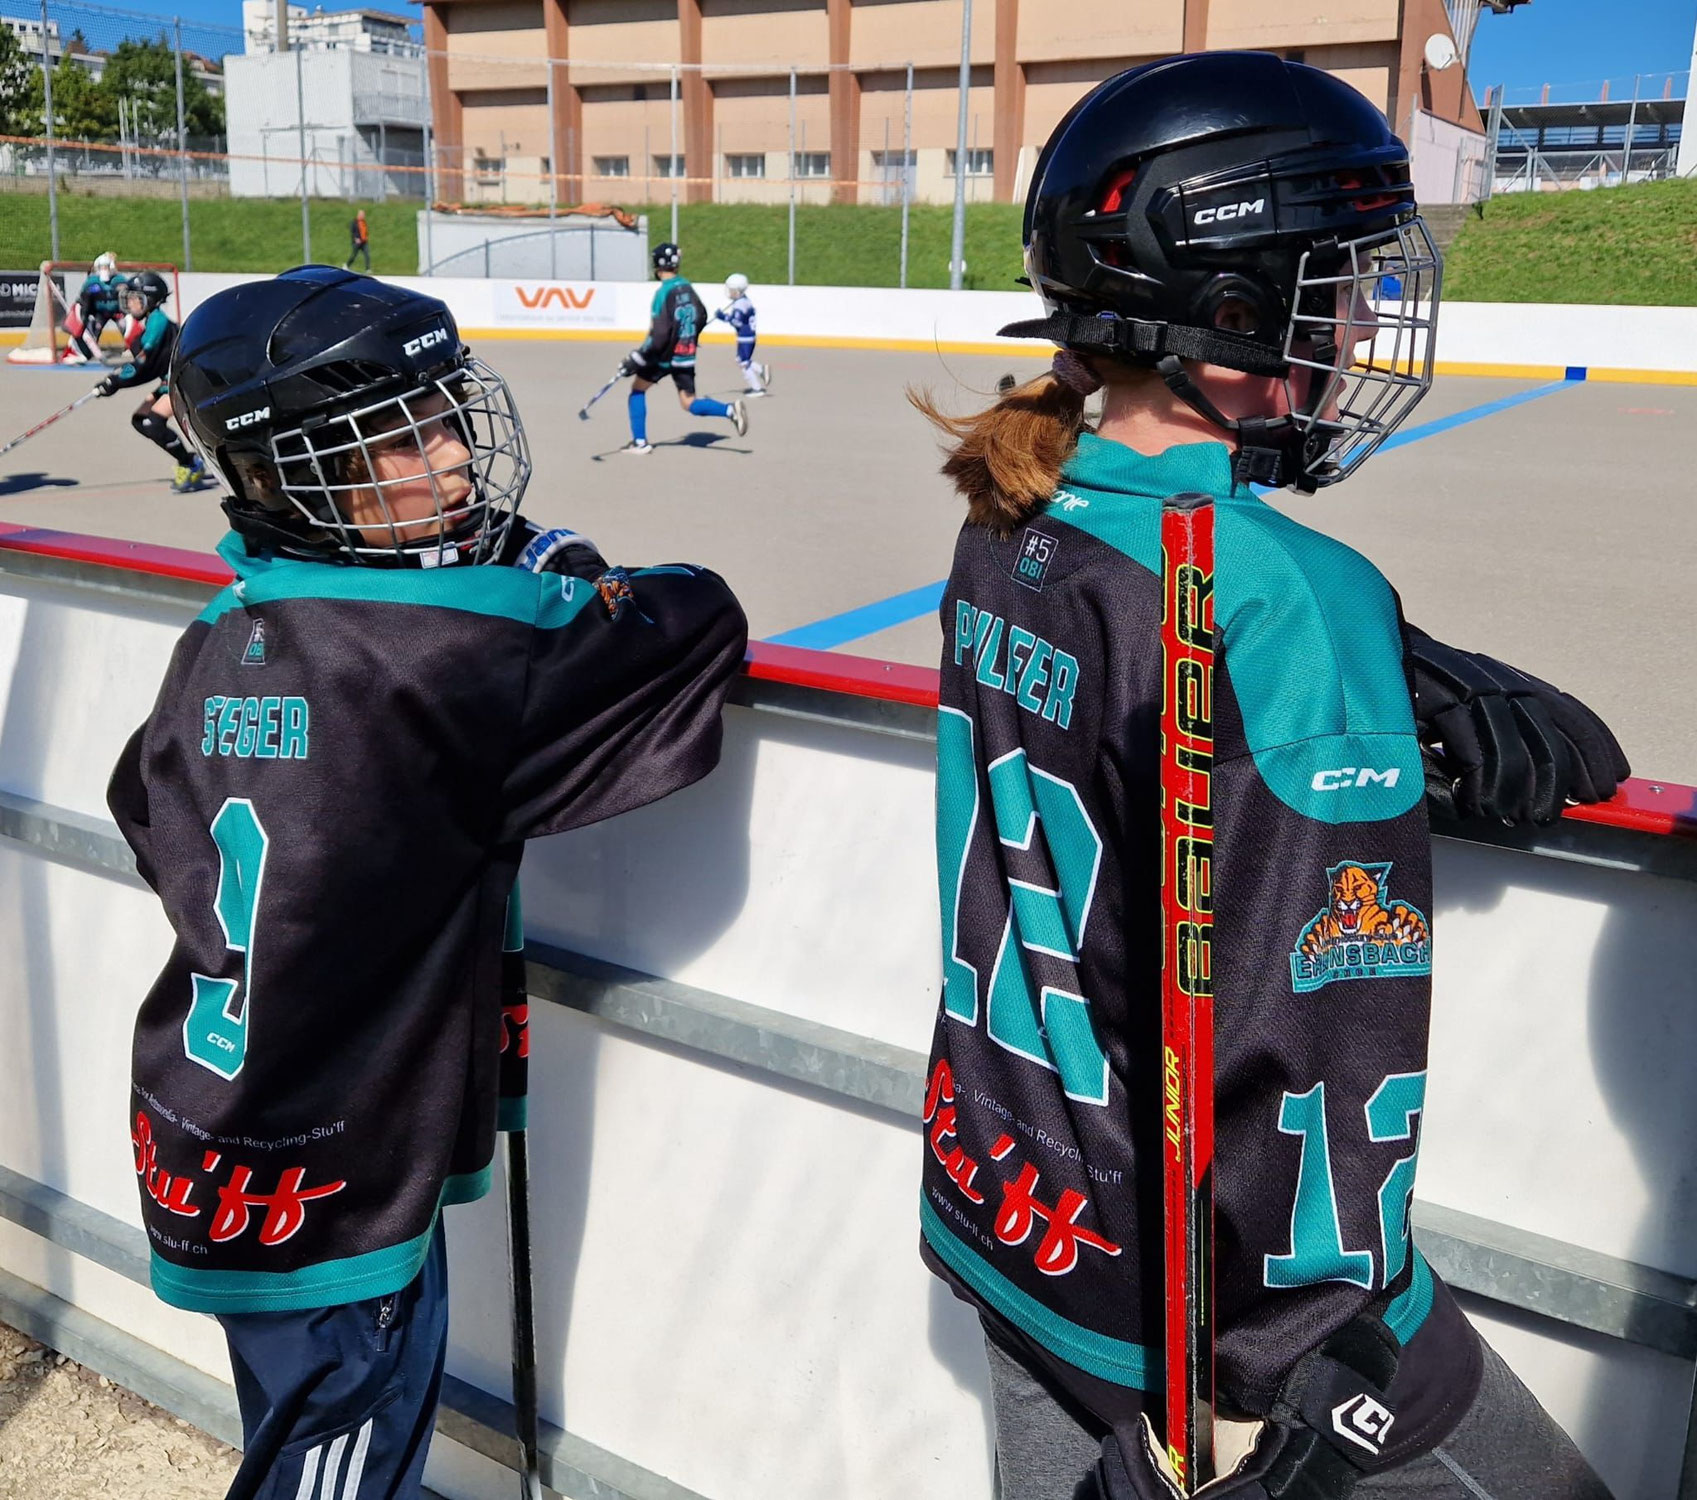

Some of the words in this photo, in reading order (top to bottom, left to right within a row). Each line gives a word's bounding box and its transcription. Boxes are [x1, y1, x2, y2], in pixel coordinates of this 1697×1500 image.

[1193, 198, 1265, 225] CCM
[402, 327, 448, 357] CCM
[225, 406, 271, 431] CCM
[1024, 535, 1052, 563] #5
[201, 695, 309, 760] SEGER
[206, 1031, 236, 1053] CCM
[1164, 1046, 1181, 1163] JUNIOR
[218, 1135, 240, 1146] and
[1016, 1117, 1035, 1139] and
[1263, 1069, 1428, 1292] 12
